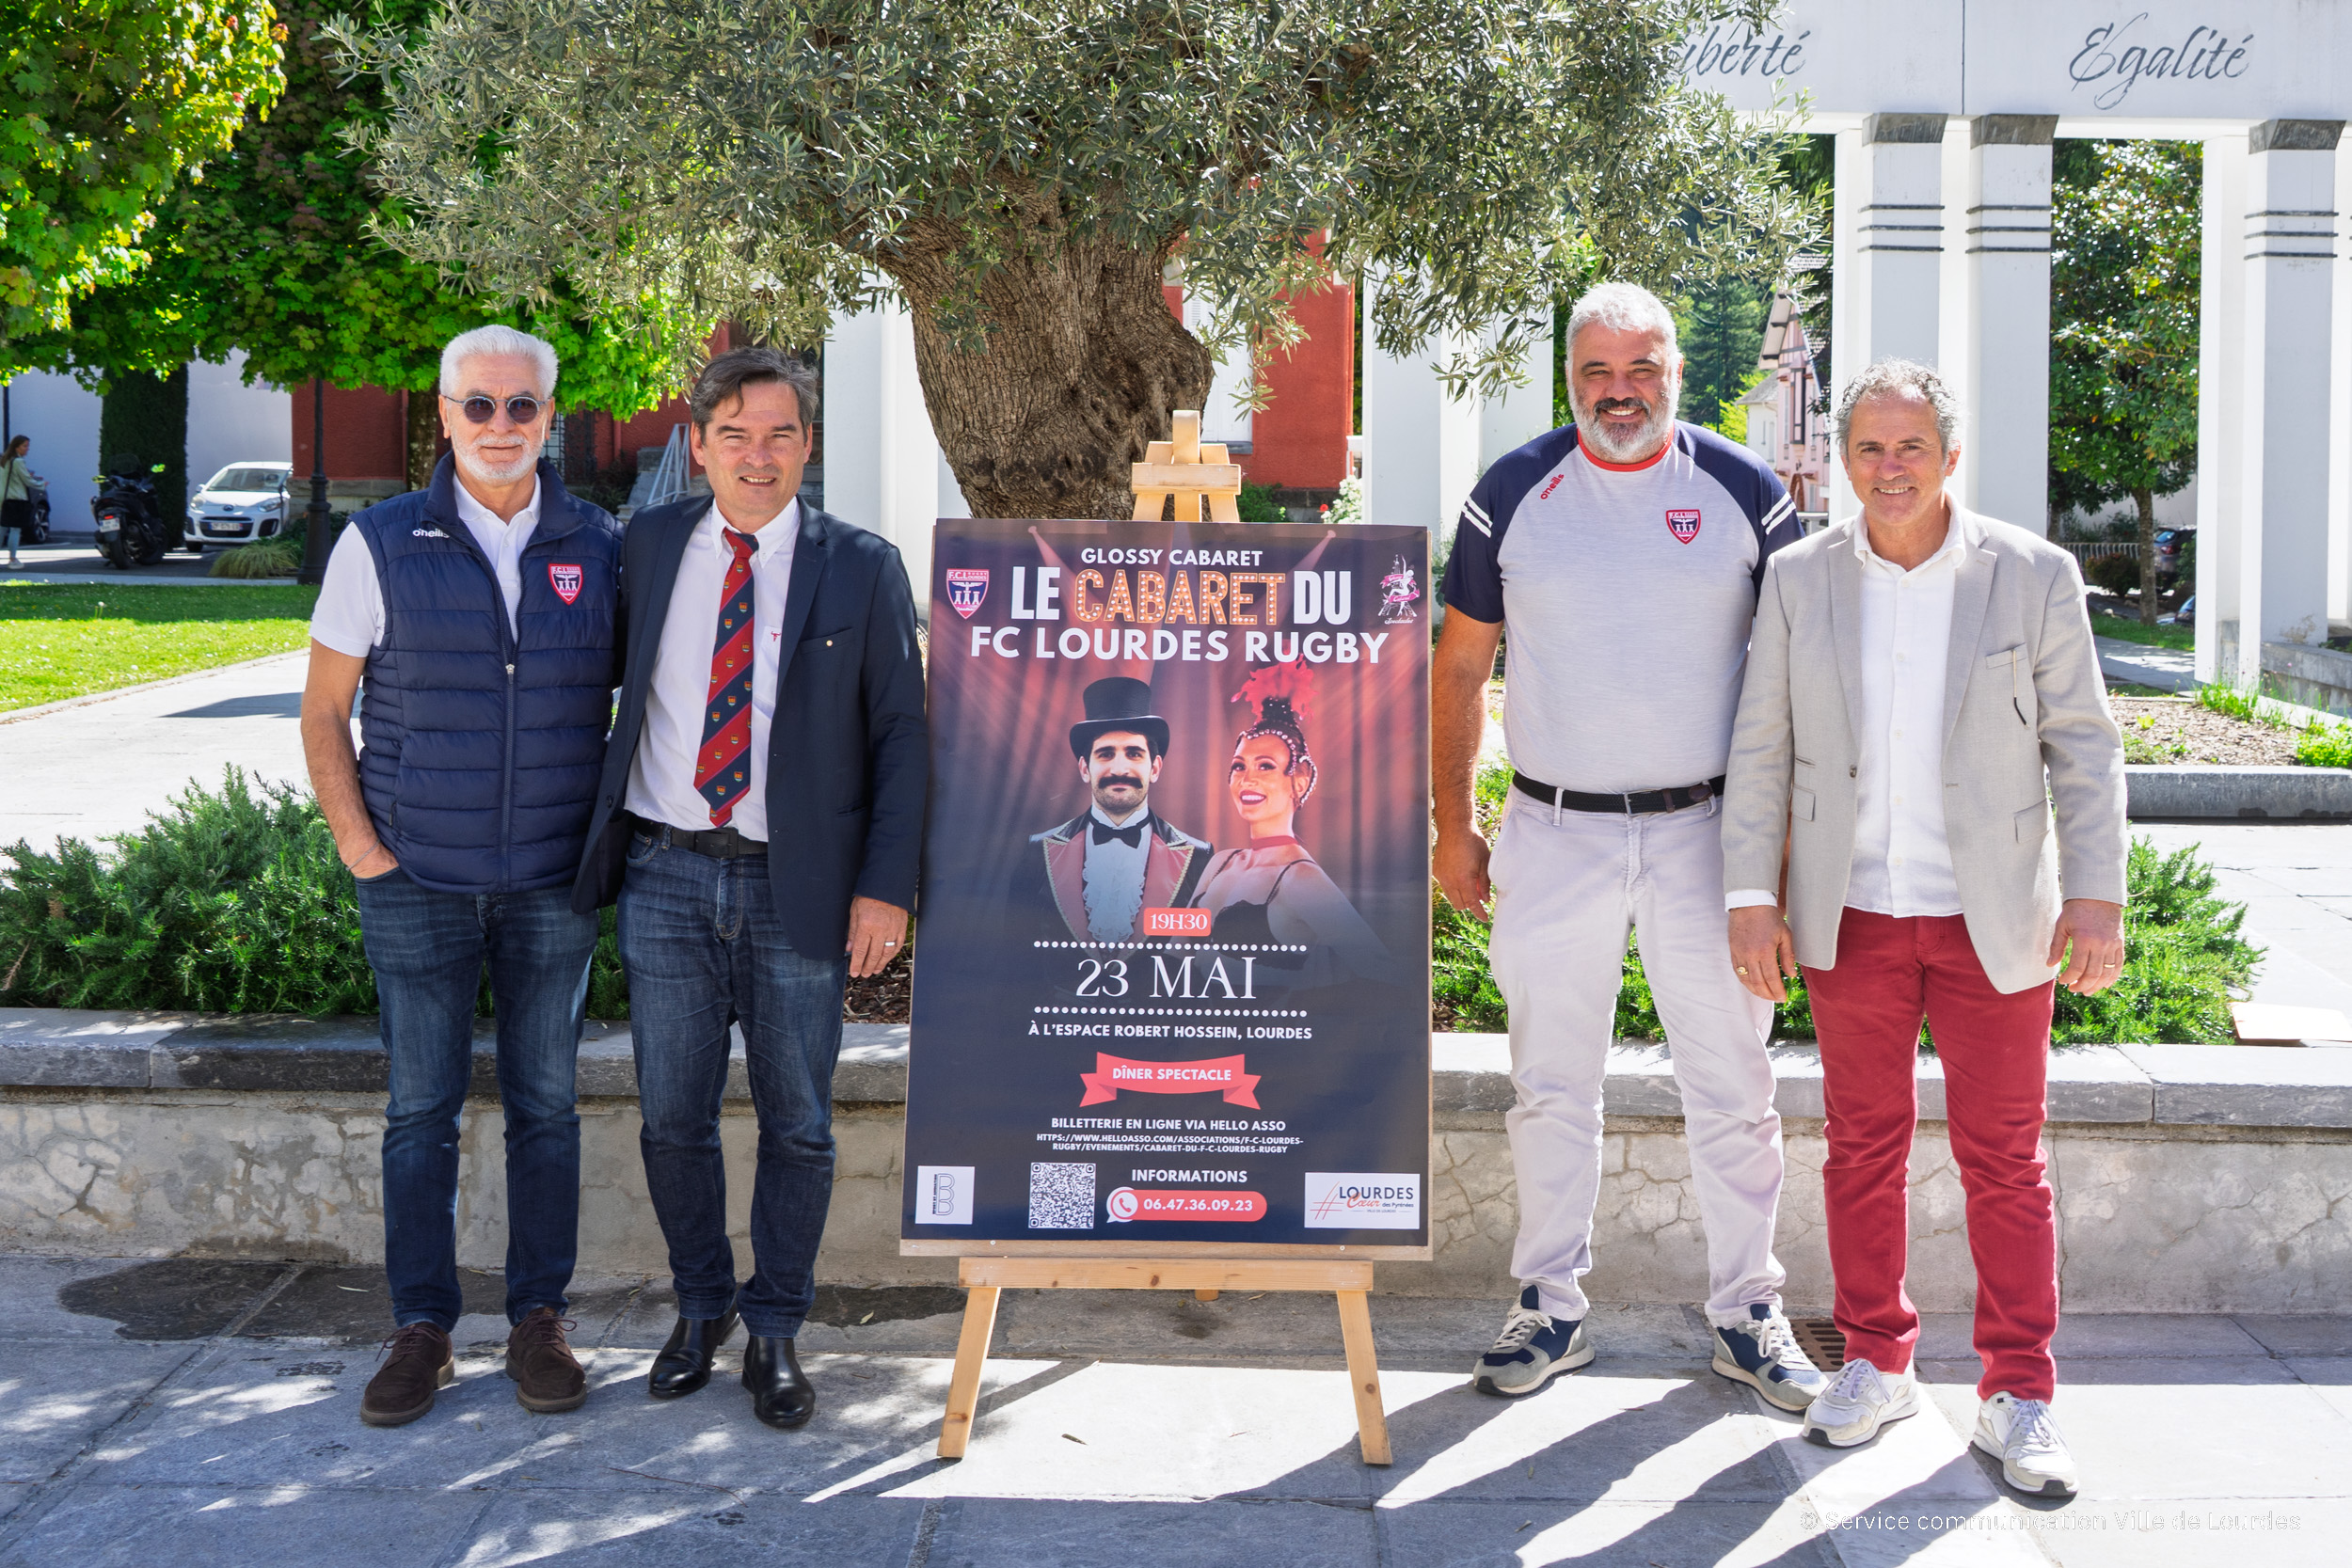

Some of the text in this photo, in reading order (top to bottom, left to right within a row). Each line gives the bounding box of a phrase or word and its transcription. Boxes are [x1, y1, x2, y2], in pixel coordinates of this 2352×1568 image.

[1677, 24, 1811, 85] iberté
[1081, 547, 1263, 566] GLOSSY CABARET
[1010, 566, 1351, 626] LE CABARET DU
[971, 626, 1390, 664] FC LOURDES RUGBY
[1150, 913, 1208, 930] 19H30
[1075, 955, 1257, 999] 23 MAI
[1028, 1020, 1312, 1040] À L'ESPACE ROBERT HOSSEIN, LOURDES
[1112, 1065, 1232, 1081] DÎNER SPECTACLE
[1051, 1117, 1287, 1132] BILLETTERIE EN LIGNE VIA HELLO ASSO
[1131, 1169, 1248, 1183] INFORMATIONS
[1339, 1186, 1414, 1199] LOURDES
[1346, 1192, 1380, 1209] Cœur
[1143, 1198, 1253, 1212] 06.47.36.09.23
